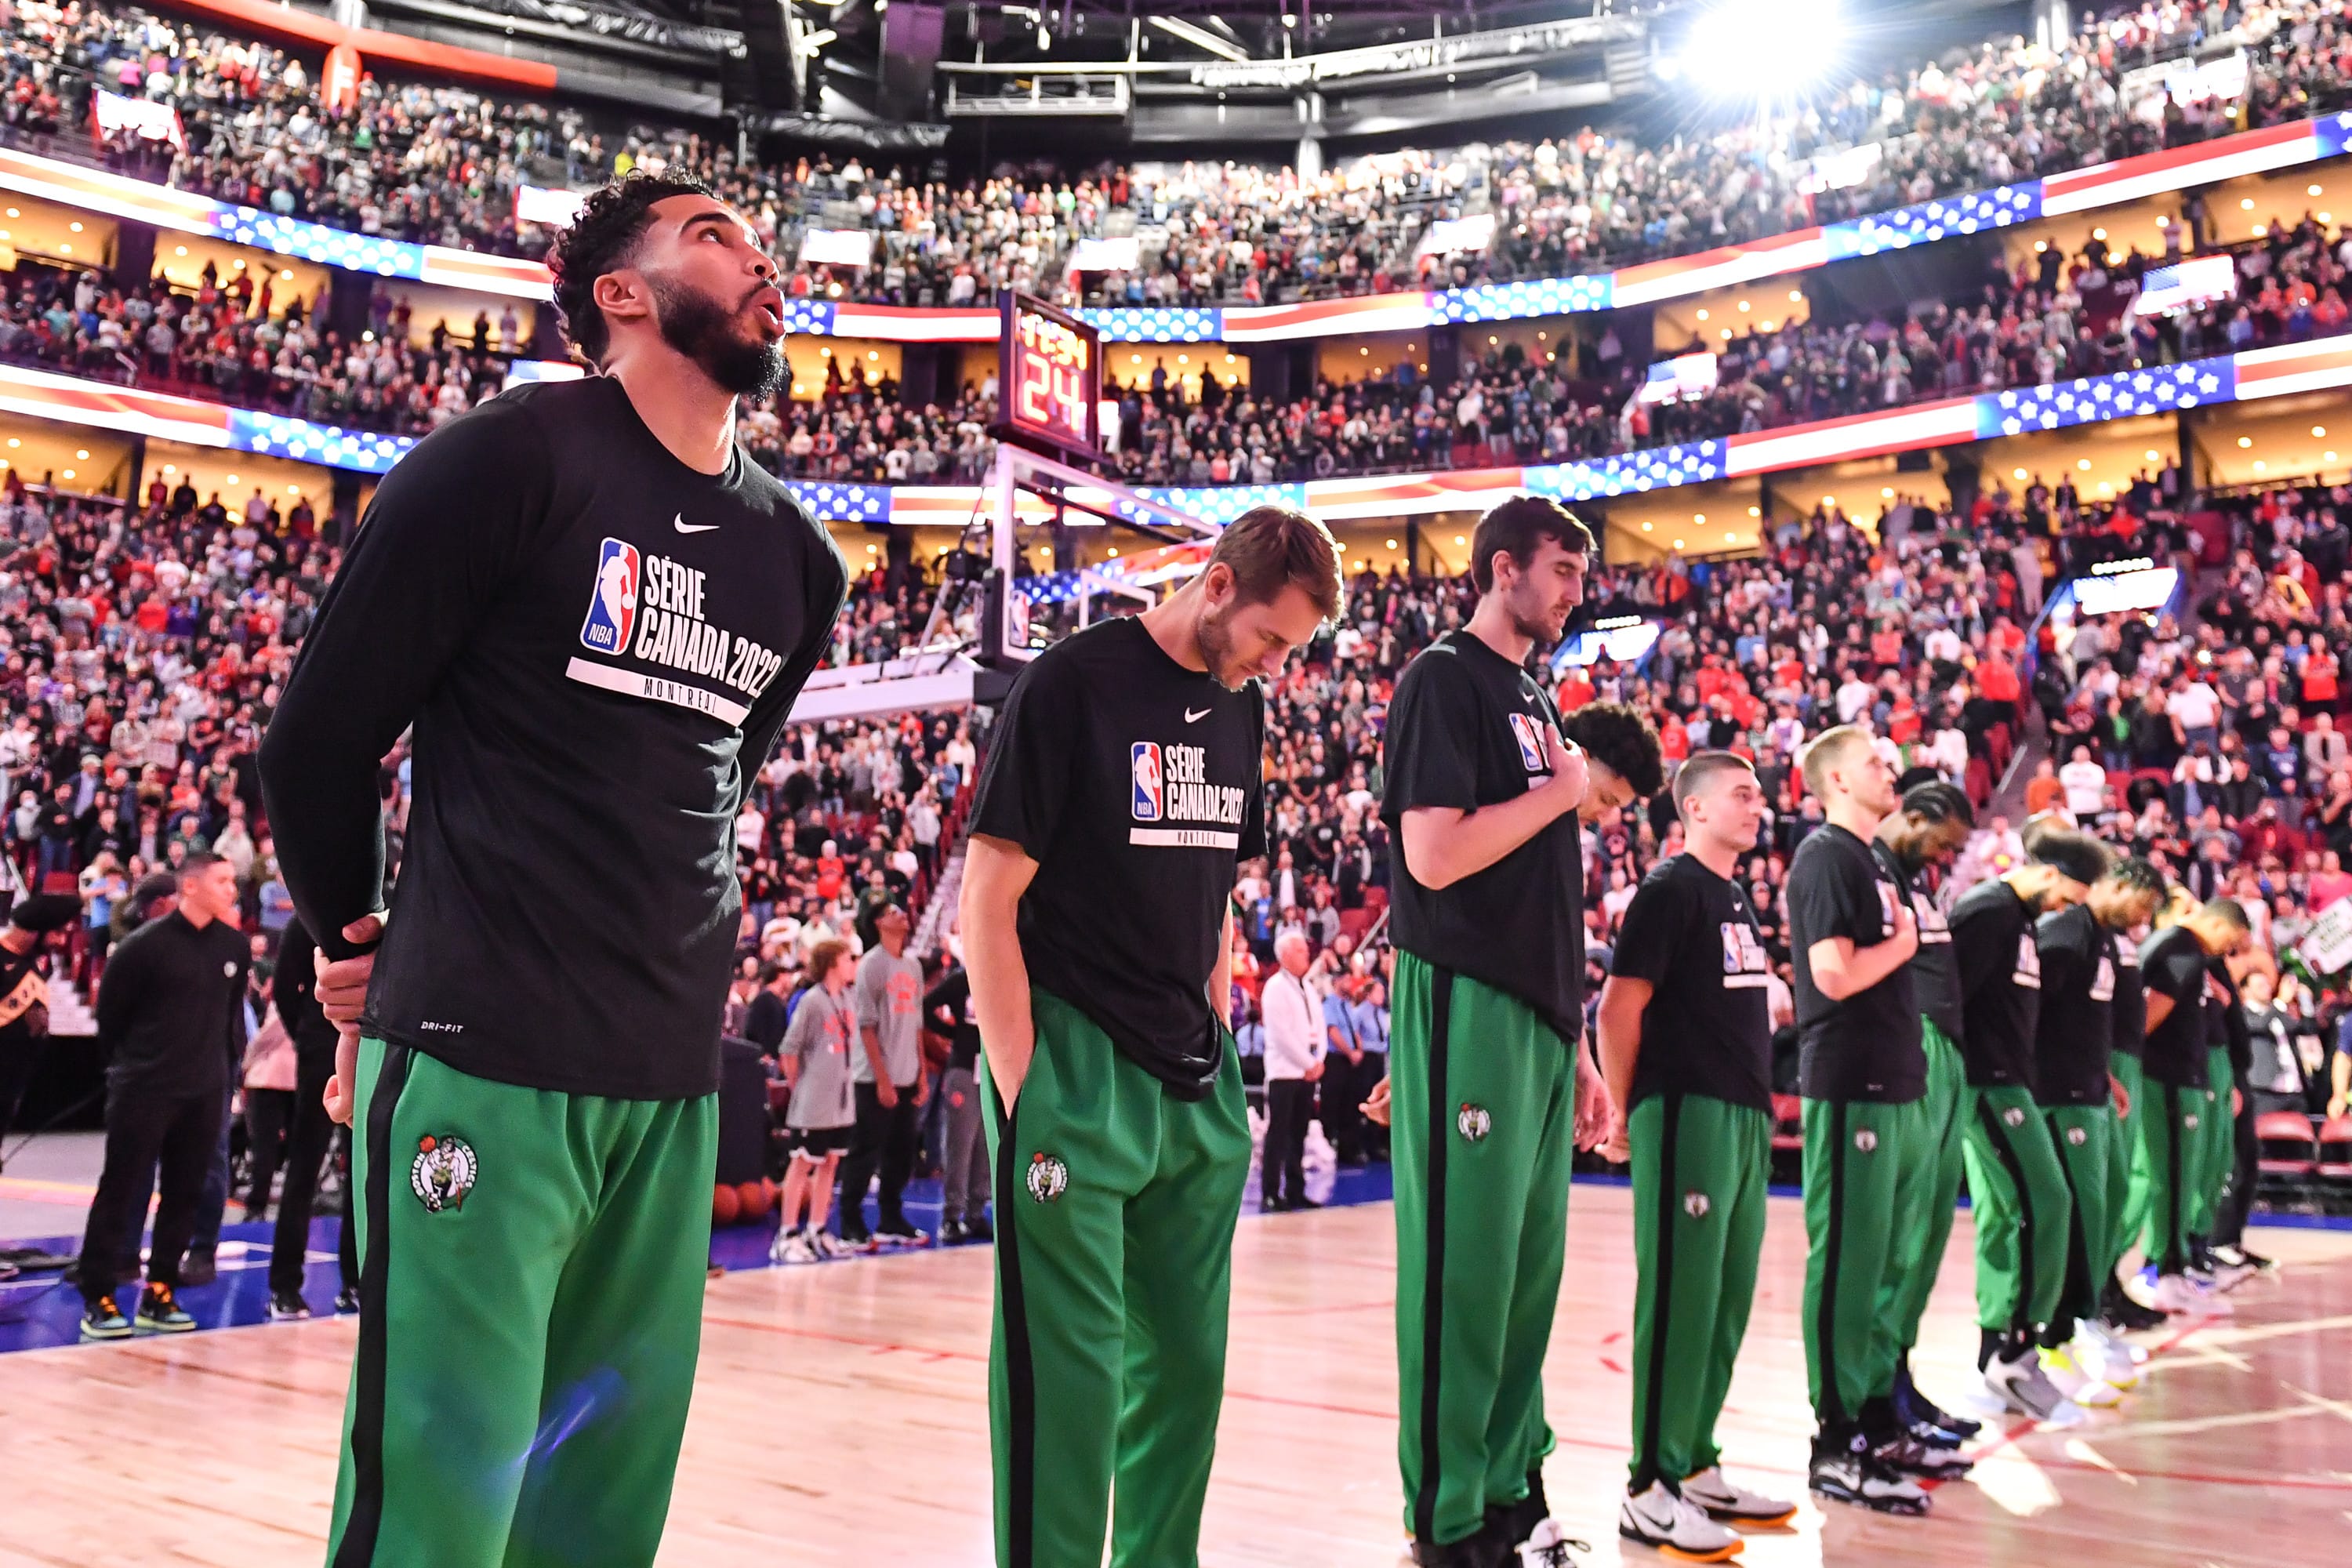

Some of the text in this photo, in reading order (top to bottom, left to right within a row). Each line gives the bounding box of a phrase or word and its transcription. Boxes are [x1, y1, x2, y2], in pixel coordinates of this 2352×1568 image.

[1023, 353, 1080, 430] 24
[644, 554, 706, 621] SÉRIE
[588, 622, 613, 645] NBA
[635, 607, 782, 699] CANADA 2022
[1165, 742, 1205, 784] SÉRIE
[1137, 802, 1152, 815] NBA
[1167, 783, 1221, 822] CANADA
[420, 1021, 464, 1033] DRI-FIT
